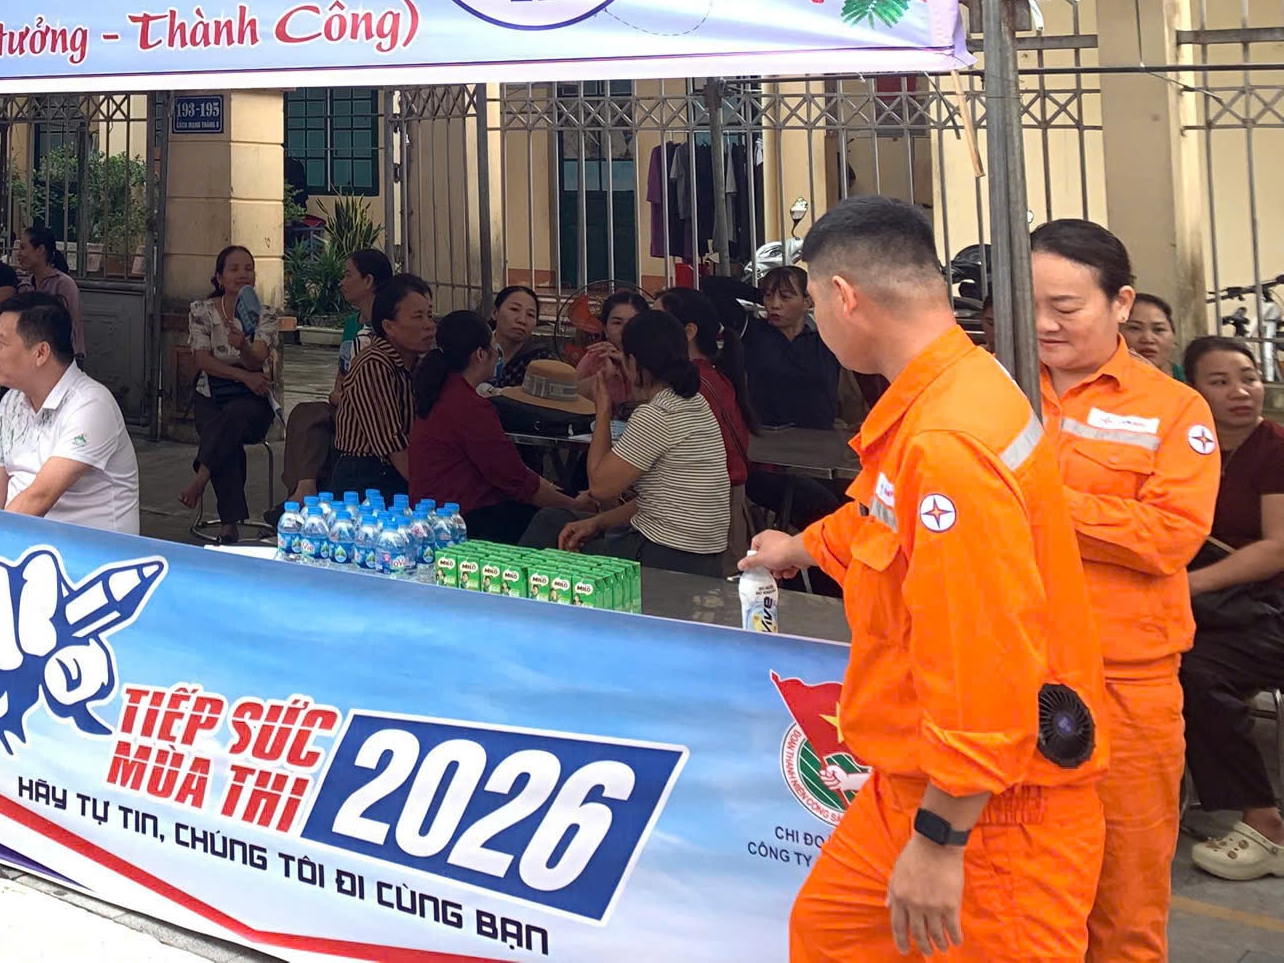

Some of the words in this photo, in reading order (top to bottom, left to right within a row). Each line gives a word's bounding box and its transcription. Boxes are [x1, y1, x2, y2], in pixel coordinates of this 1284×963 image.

[127, 3, 260, 52] Thành
[177, 102, 220, 117] 193-195
[119, 686, 223, 747] TIẾP
[228, 694, 340, 768] SỨC
[107, 740, 211, 809] MÙA
[221, 764, 311, 833] THI
[332, 727, 636, 892] 2026
[748, 841, 790, 863] CÔNG
[795, 852, 813, 868] TY
[775, 826, 799, 844] CHI
[804, 832, 828, 849] ĐO
[77, 794, 112, 826] TỰ
[119, 804, 165, 843] TIN,
[175, 820, 267, 869] CHÚNG
[277, 851, 325, 888] TÔI
[335, 870, 364, 900] ĐI
[377, 878, 464, 928] CÙNG
[477, 913, 550, 956] BẠN
